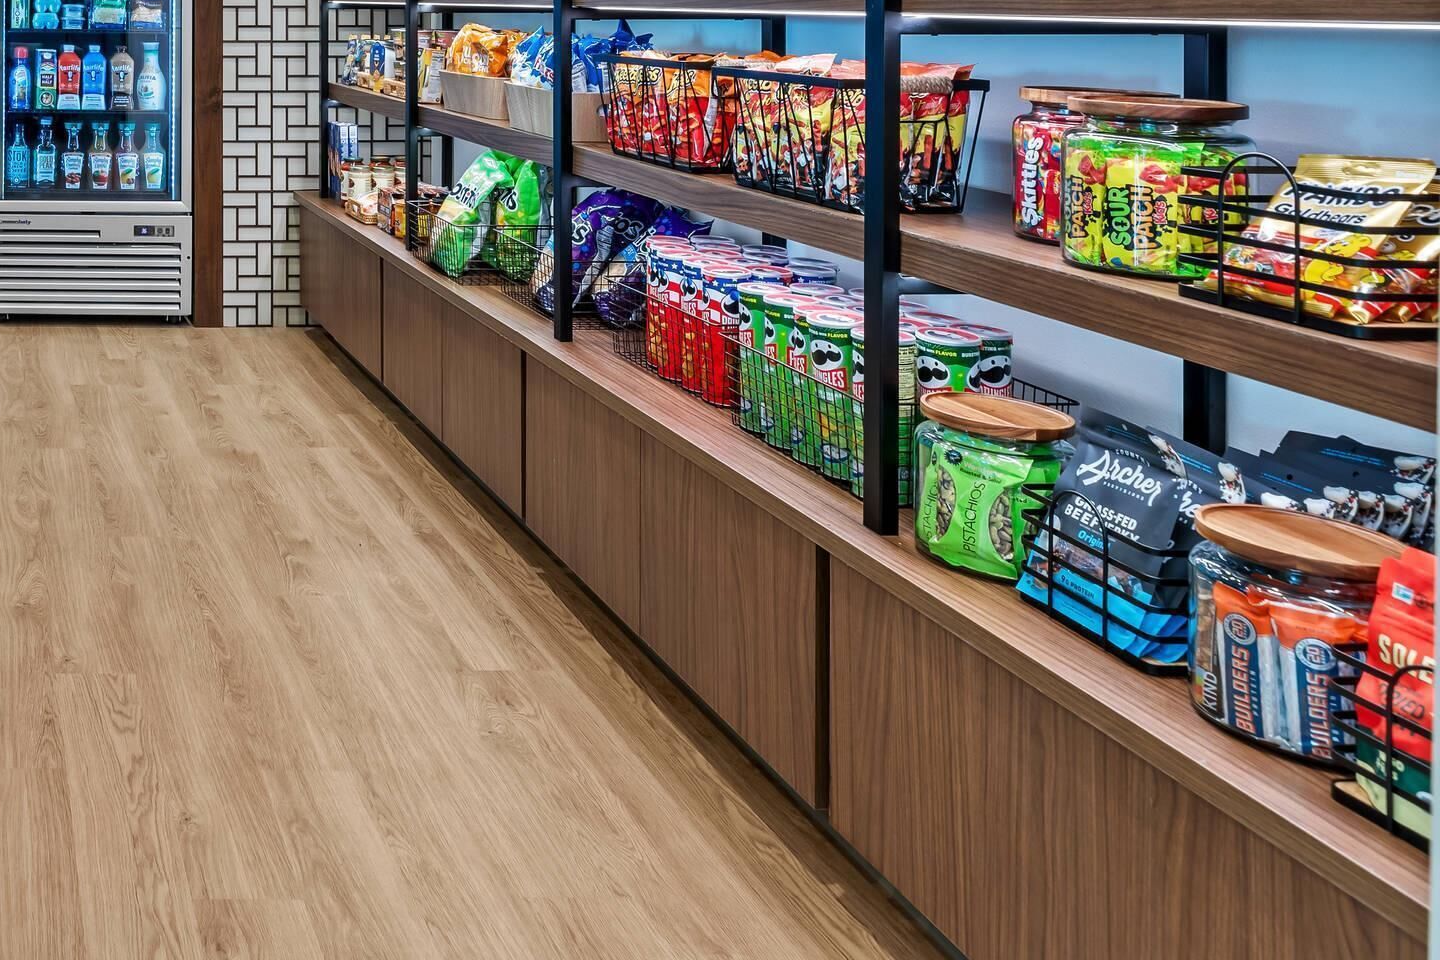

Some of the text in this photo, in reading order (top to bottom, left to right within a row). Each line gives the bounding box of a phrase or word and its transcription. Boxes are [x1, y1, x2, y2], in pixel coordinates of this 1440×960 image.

[1021, 135, 1046, 227] Skittles
[1108, 186, 1131, 247] SOUR
[1131, 184, 1155, 251] PATCH
[1076, 449, 1163, 507] Archer
[963, 481, 986, 553] PISTACHIOS
[1064, 503, 1099, 529] BEEF
[1077, 529, 1104, 550] Origin
[1202, 671, 1218, 711] KIND
[1232, 644, 1256, 734] BUILDERS
